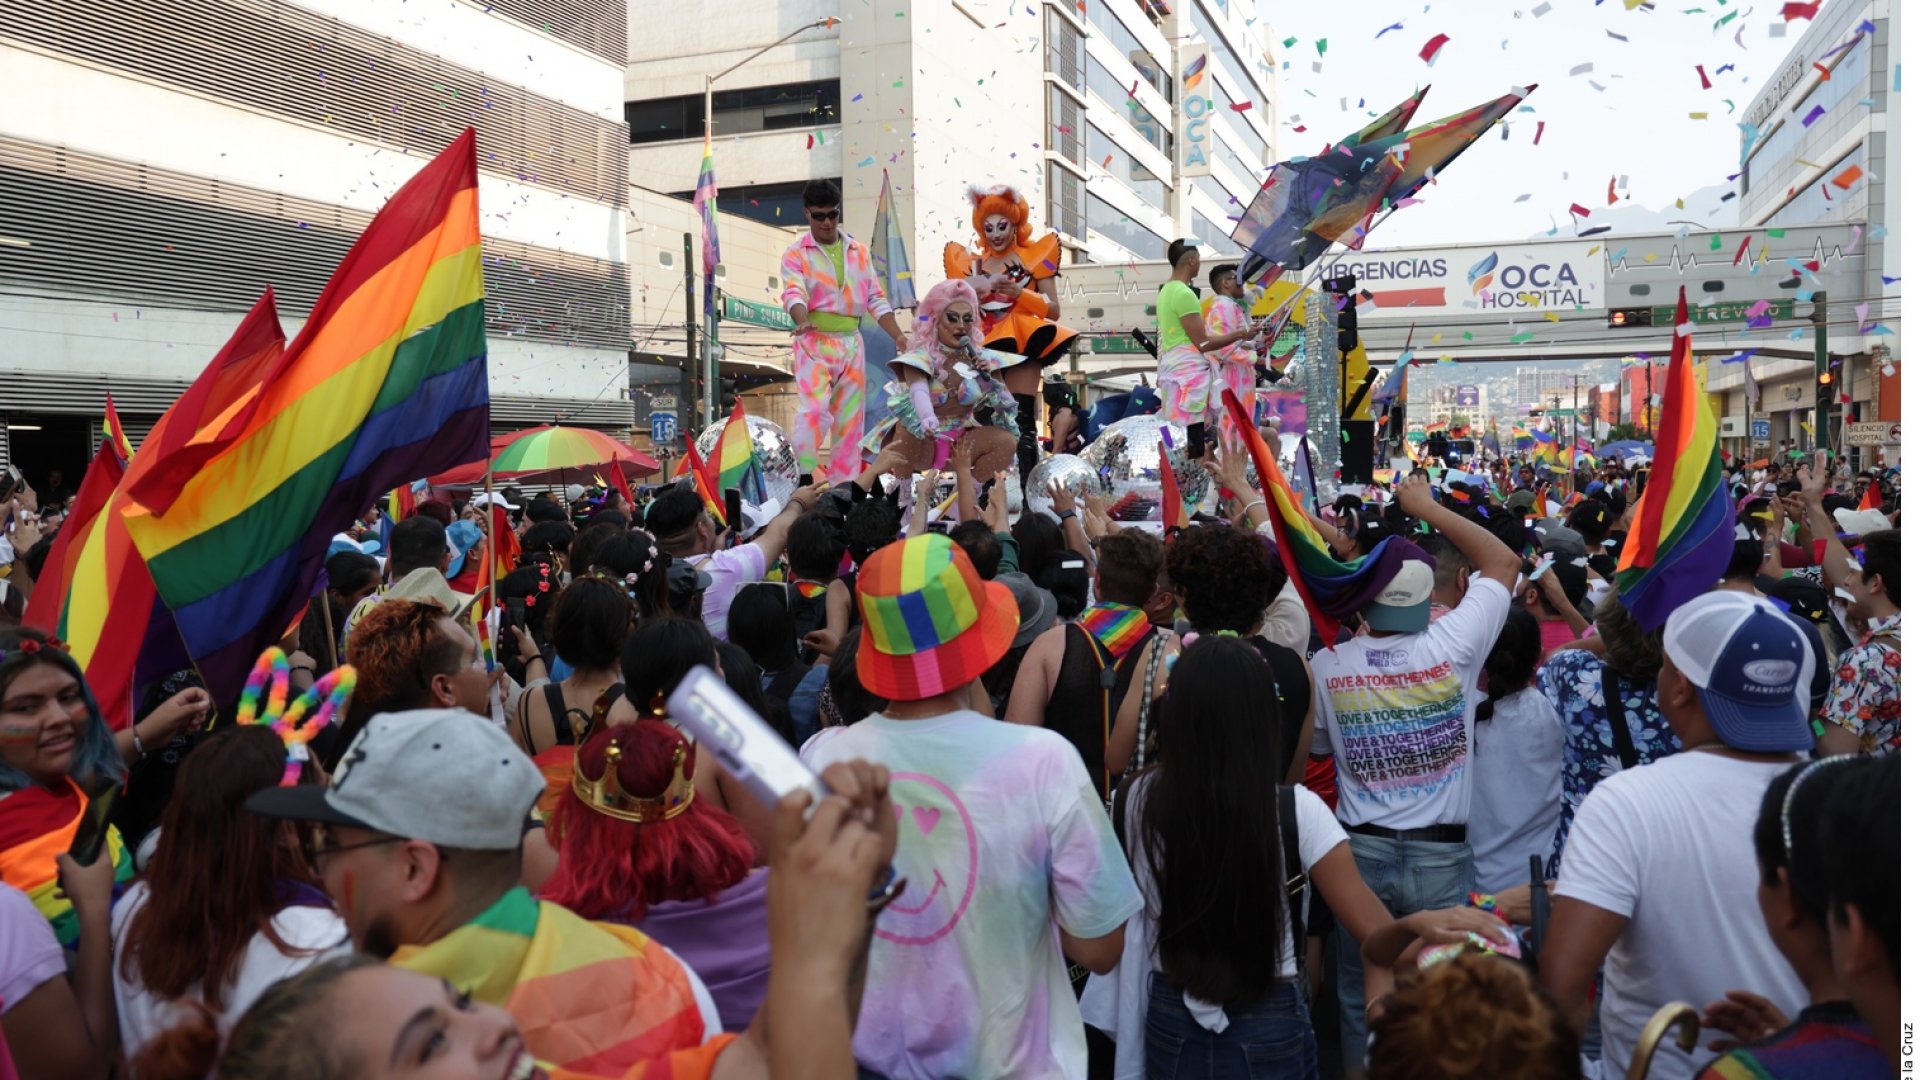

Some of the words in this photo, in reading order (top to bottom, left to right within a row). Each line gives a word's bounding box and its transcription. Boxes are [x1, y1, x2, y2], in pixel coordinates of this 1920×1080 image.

[1184, 94, 1207, 167] OCA
[1318, 259, 1447, 281] URGENCIAS
[1500, 262, 1578, 289] OCA
[1482, 289, 1590, 309] HOSPITAL
[734, 302, 755, 319] PINO
[760, 307, 792, 327] SUAREZ
[1695, 304, 1779, 321] TREVO
[655, 421, 674, 441] 15
[1754, 425, 1769, 437] 15
[1848, 424, 1885, 433] SILENCIO
[1848, 434, 1884, 442] HOSPITAL
[1326, 676, 1355, 690] LOVE
[1355, 675, 1364, 687] &
[1336, 712, 1363, 725] LOVE
[1364, 711, 1373, 723] &
[1339, 724, 1367, 737] LOVE
[1367, 724, 1377, 735] &
[1343, 737, 1370, 749] LOVE
[1370, 736, 1380, 747] &
[1346, 748, 1372, 760] LOVE
[1373, 748, 1383, 759] &
[1348, 760, 1375, 773] LOVE
[1376, 759, 1386, 771] &
[1379, 770, 1388, 781] &
